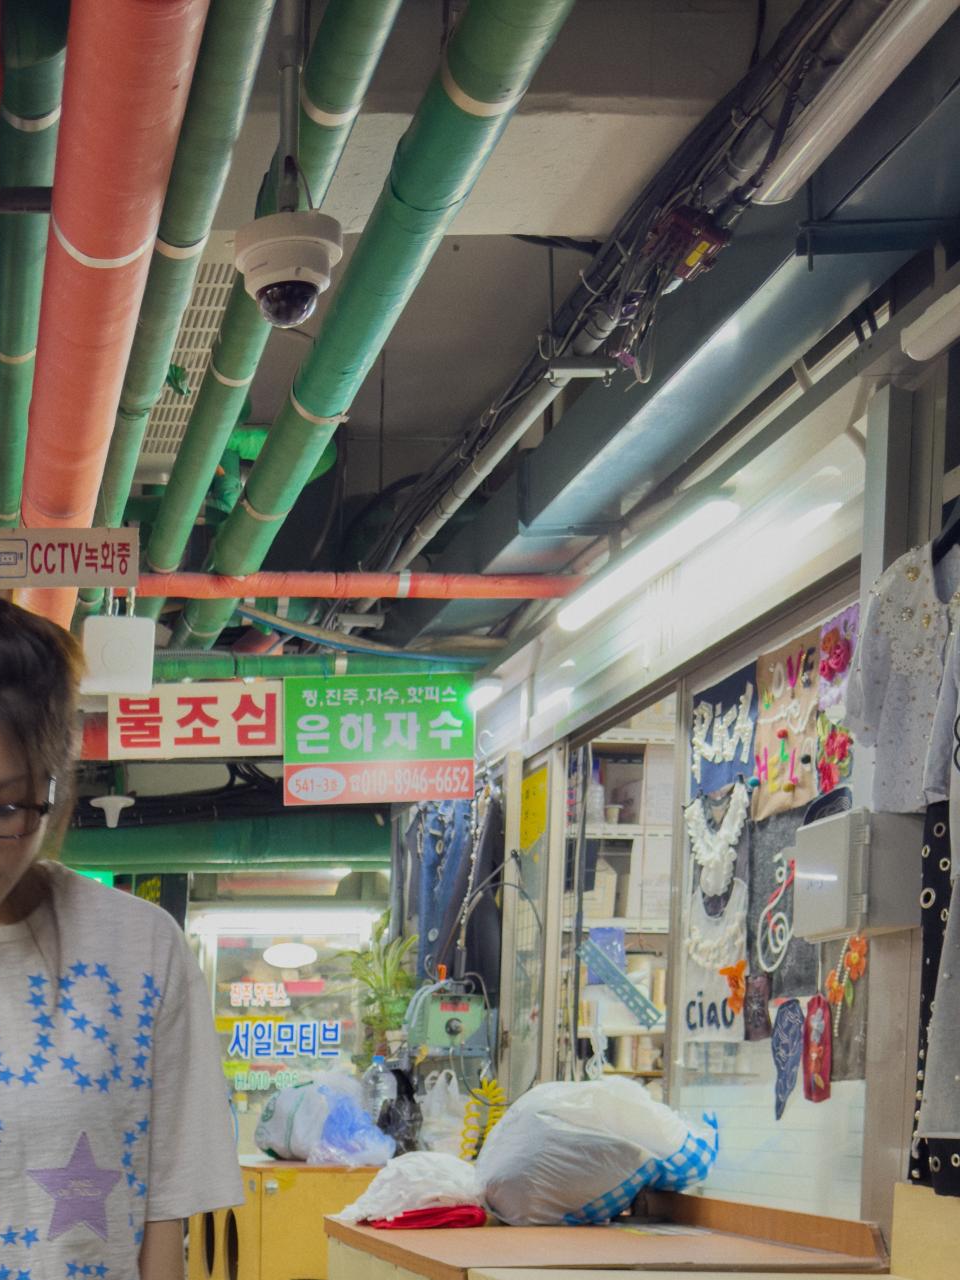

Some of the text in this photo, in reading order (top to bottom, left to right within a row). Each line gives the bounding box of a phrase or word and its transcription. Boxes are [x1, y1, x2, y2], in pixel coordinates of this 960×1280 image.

[116, 693, 277, 749] 불조심
[296, 710, 464, 755] 은하자수
[229, 1022, 340, 1057] 서일모티브
